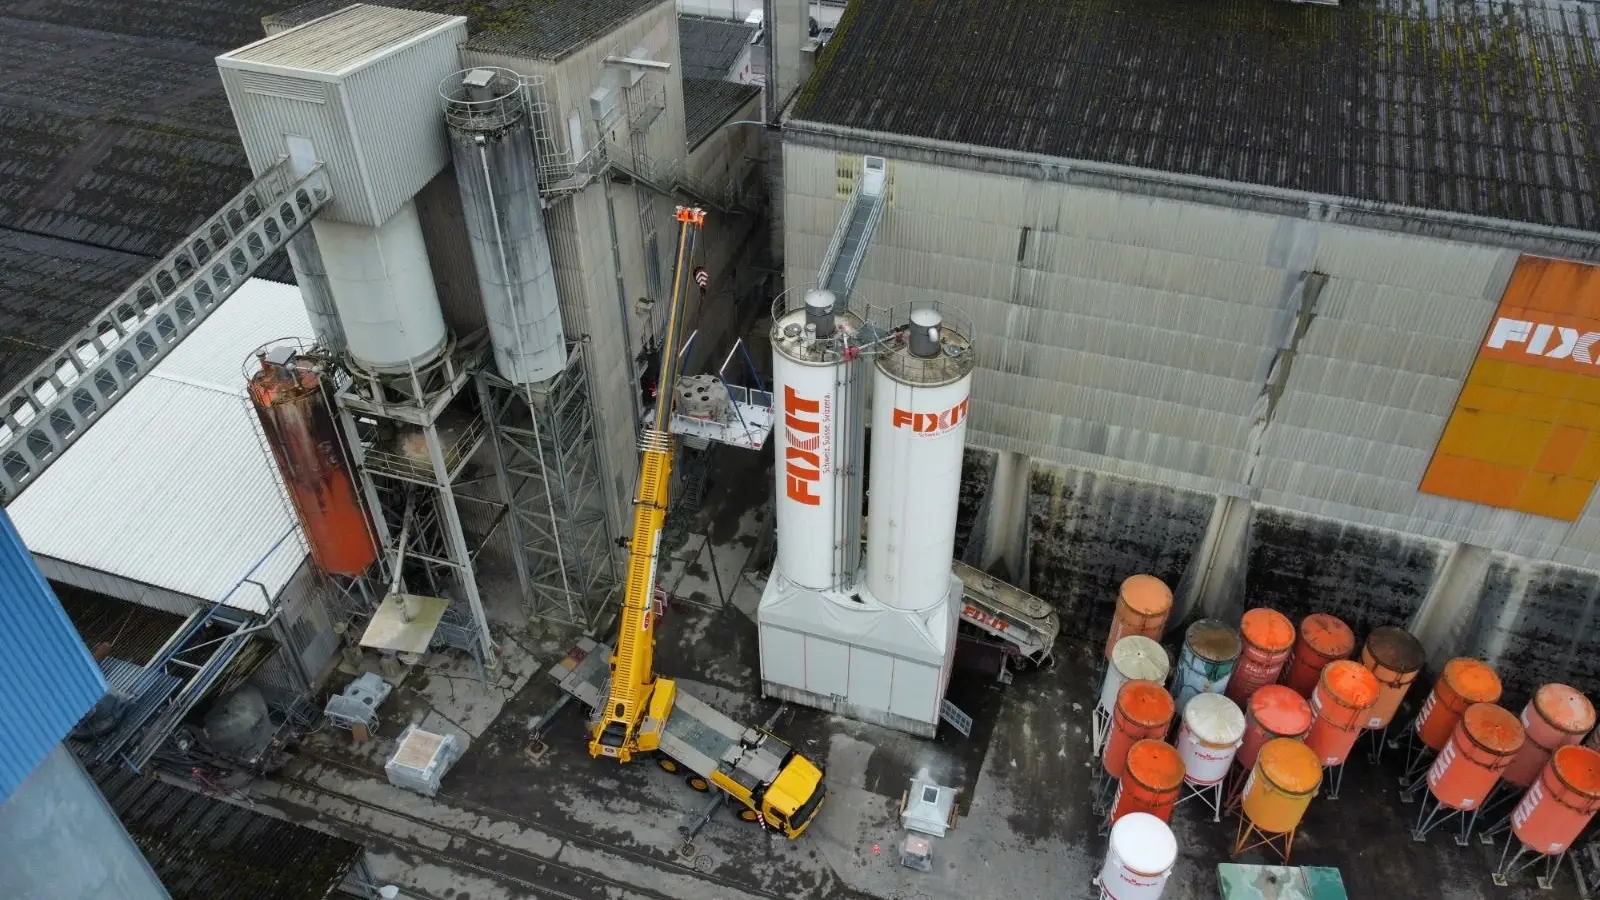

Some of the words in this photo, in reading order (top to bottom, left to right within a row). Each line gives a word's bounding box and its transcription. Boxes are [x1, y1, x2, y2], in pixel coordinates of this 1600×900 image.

[1486, 317, 1600, 365] FIX
[784, 383, 820, 506] FIXIT
[963, 604, 1009, 632] FIXIT
[1428, 738, 1456, 786] FIXIT
[1513, 779, 1543, 829] FIXIT
